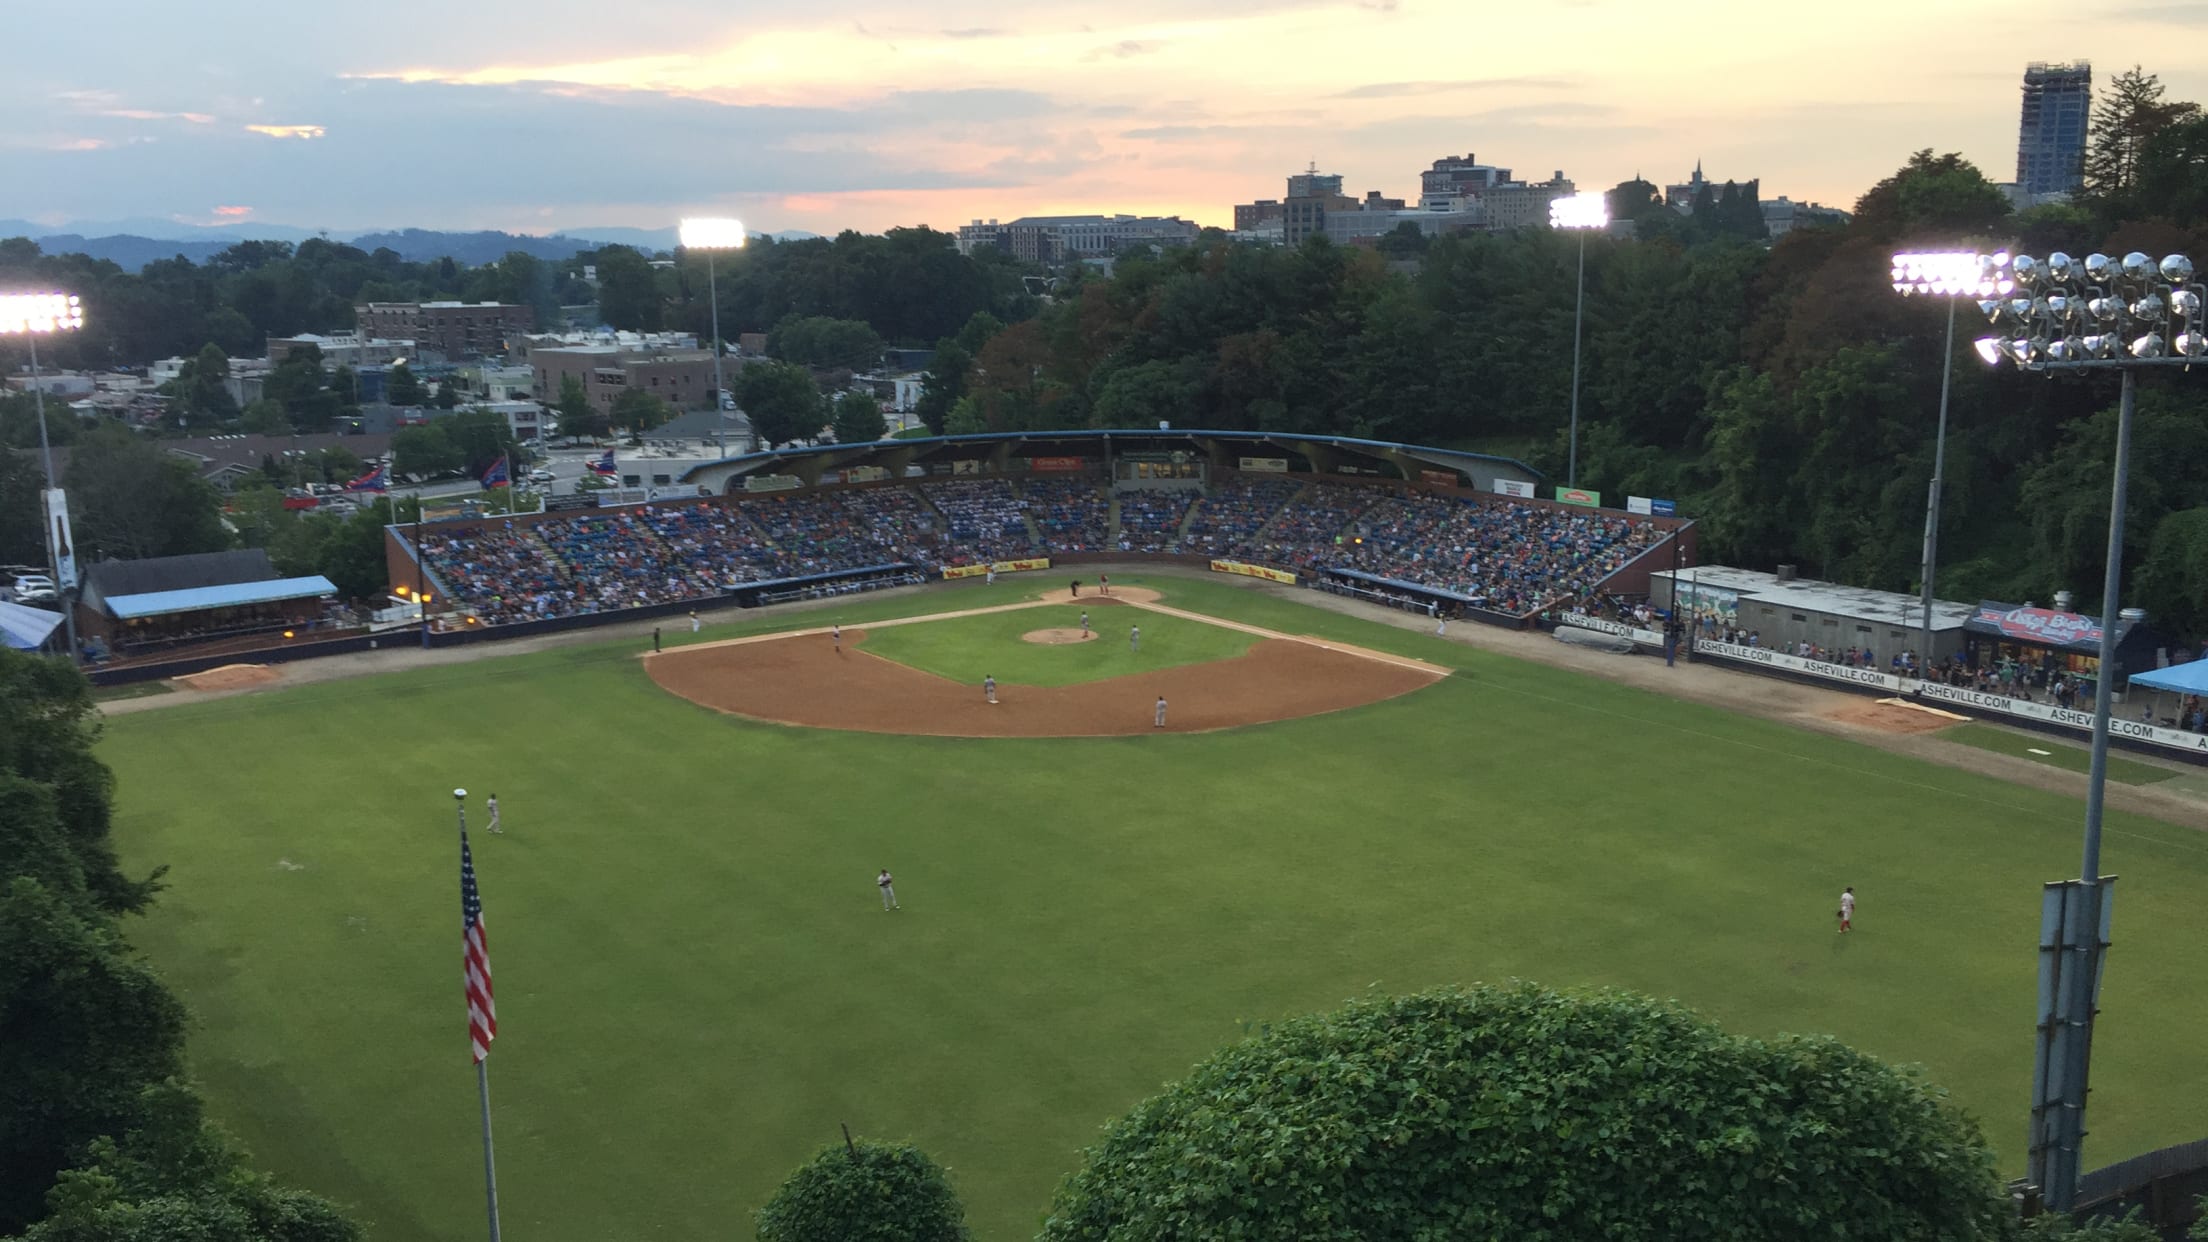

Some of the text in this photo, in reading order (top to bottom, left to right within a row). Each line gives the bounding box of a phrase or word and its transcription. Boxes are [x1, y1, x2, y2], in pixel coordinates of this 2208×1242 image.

[1700, 640, 1772, 663] ASHEVILLE.COM
[1803, 661, 1885, 685] ASHEVILLE.COM
[1920, 683, 2011, 710] ASHEVILLE.COM
